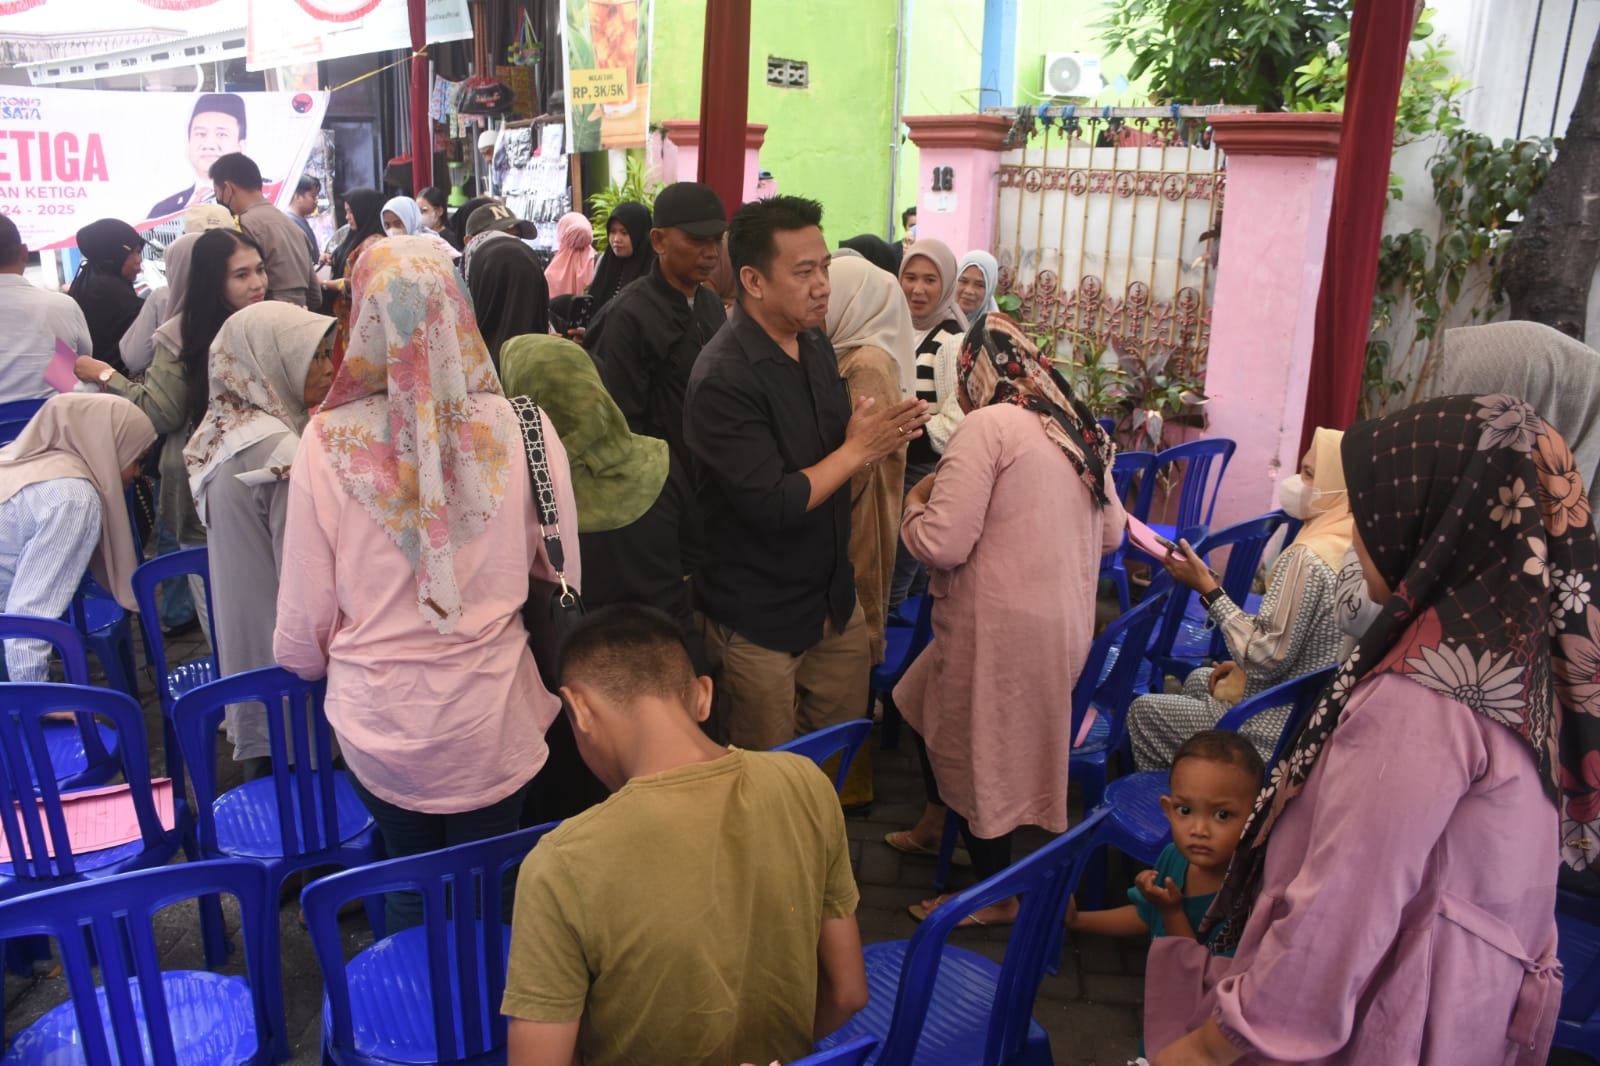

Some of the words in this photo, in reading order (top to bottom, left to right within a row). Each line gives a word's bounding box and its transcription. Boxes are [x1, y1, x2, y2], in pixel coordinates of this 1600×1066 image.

[594, 83, 624, 98] 3K/5K
[25, 186, 88, 199] KETIGA
[37, 204, 76, 215] 2025
[489, 205, 510, 220] N
